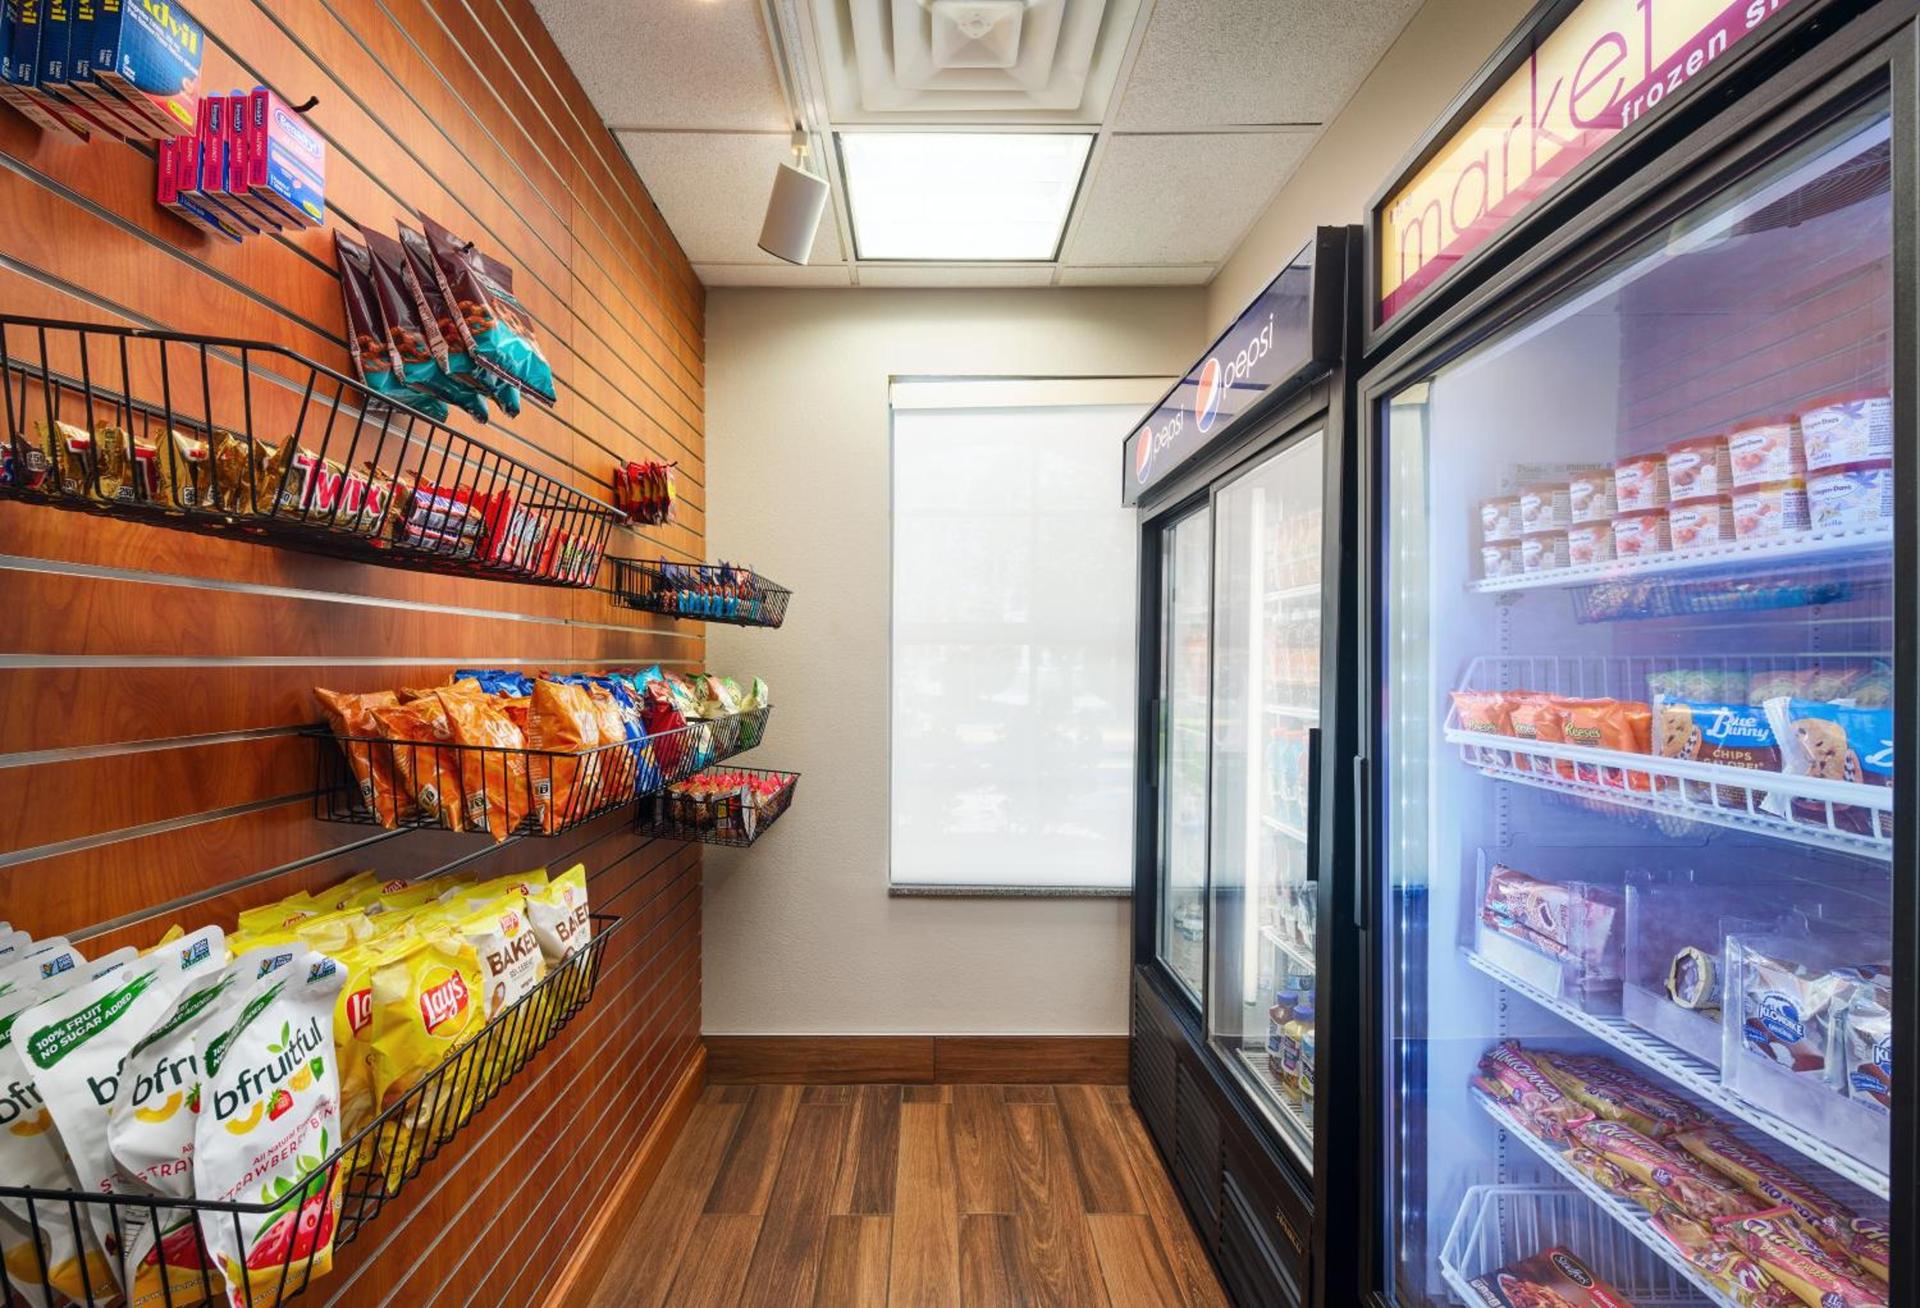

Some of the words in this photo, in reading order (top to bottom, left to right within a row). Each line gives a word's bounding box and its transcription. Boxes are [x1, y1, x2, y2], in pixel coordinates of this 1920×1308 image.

[1621, 28, 1727, 129] frozen
[1221, 312, 1274, 400] pepsi
[1151, 404, 1185, 461] pepsi
[1712, 749, 1752, 761] CHIPS
[36, 1024, 66, 1051] 100%
[66, 1003, 103, 1031] FRUIT
[41, 1043, 59, 1060] NO
[60, 1017, 103, 1047] SUGAR
[105, 992, 132, 1020] ADDED
[213, 1016, 323, 1121] bfruitful
